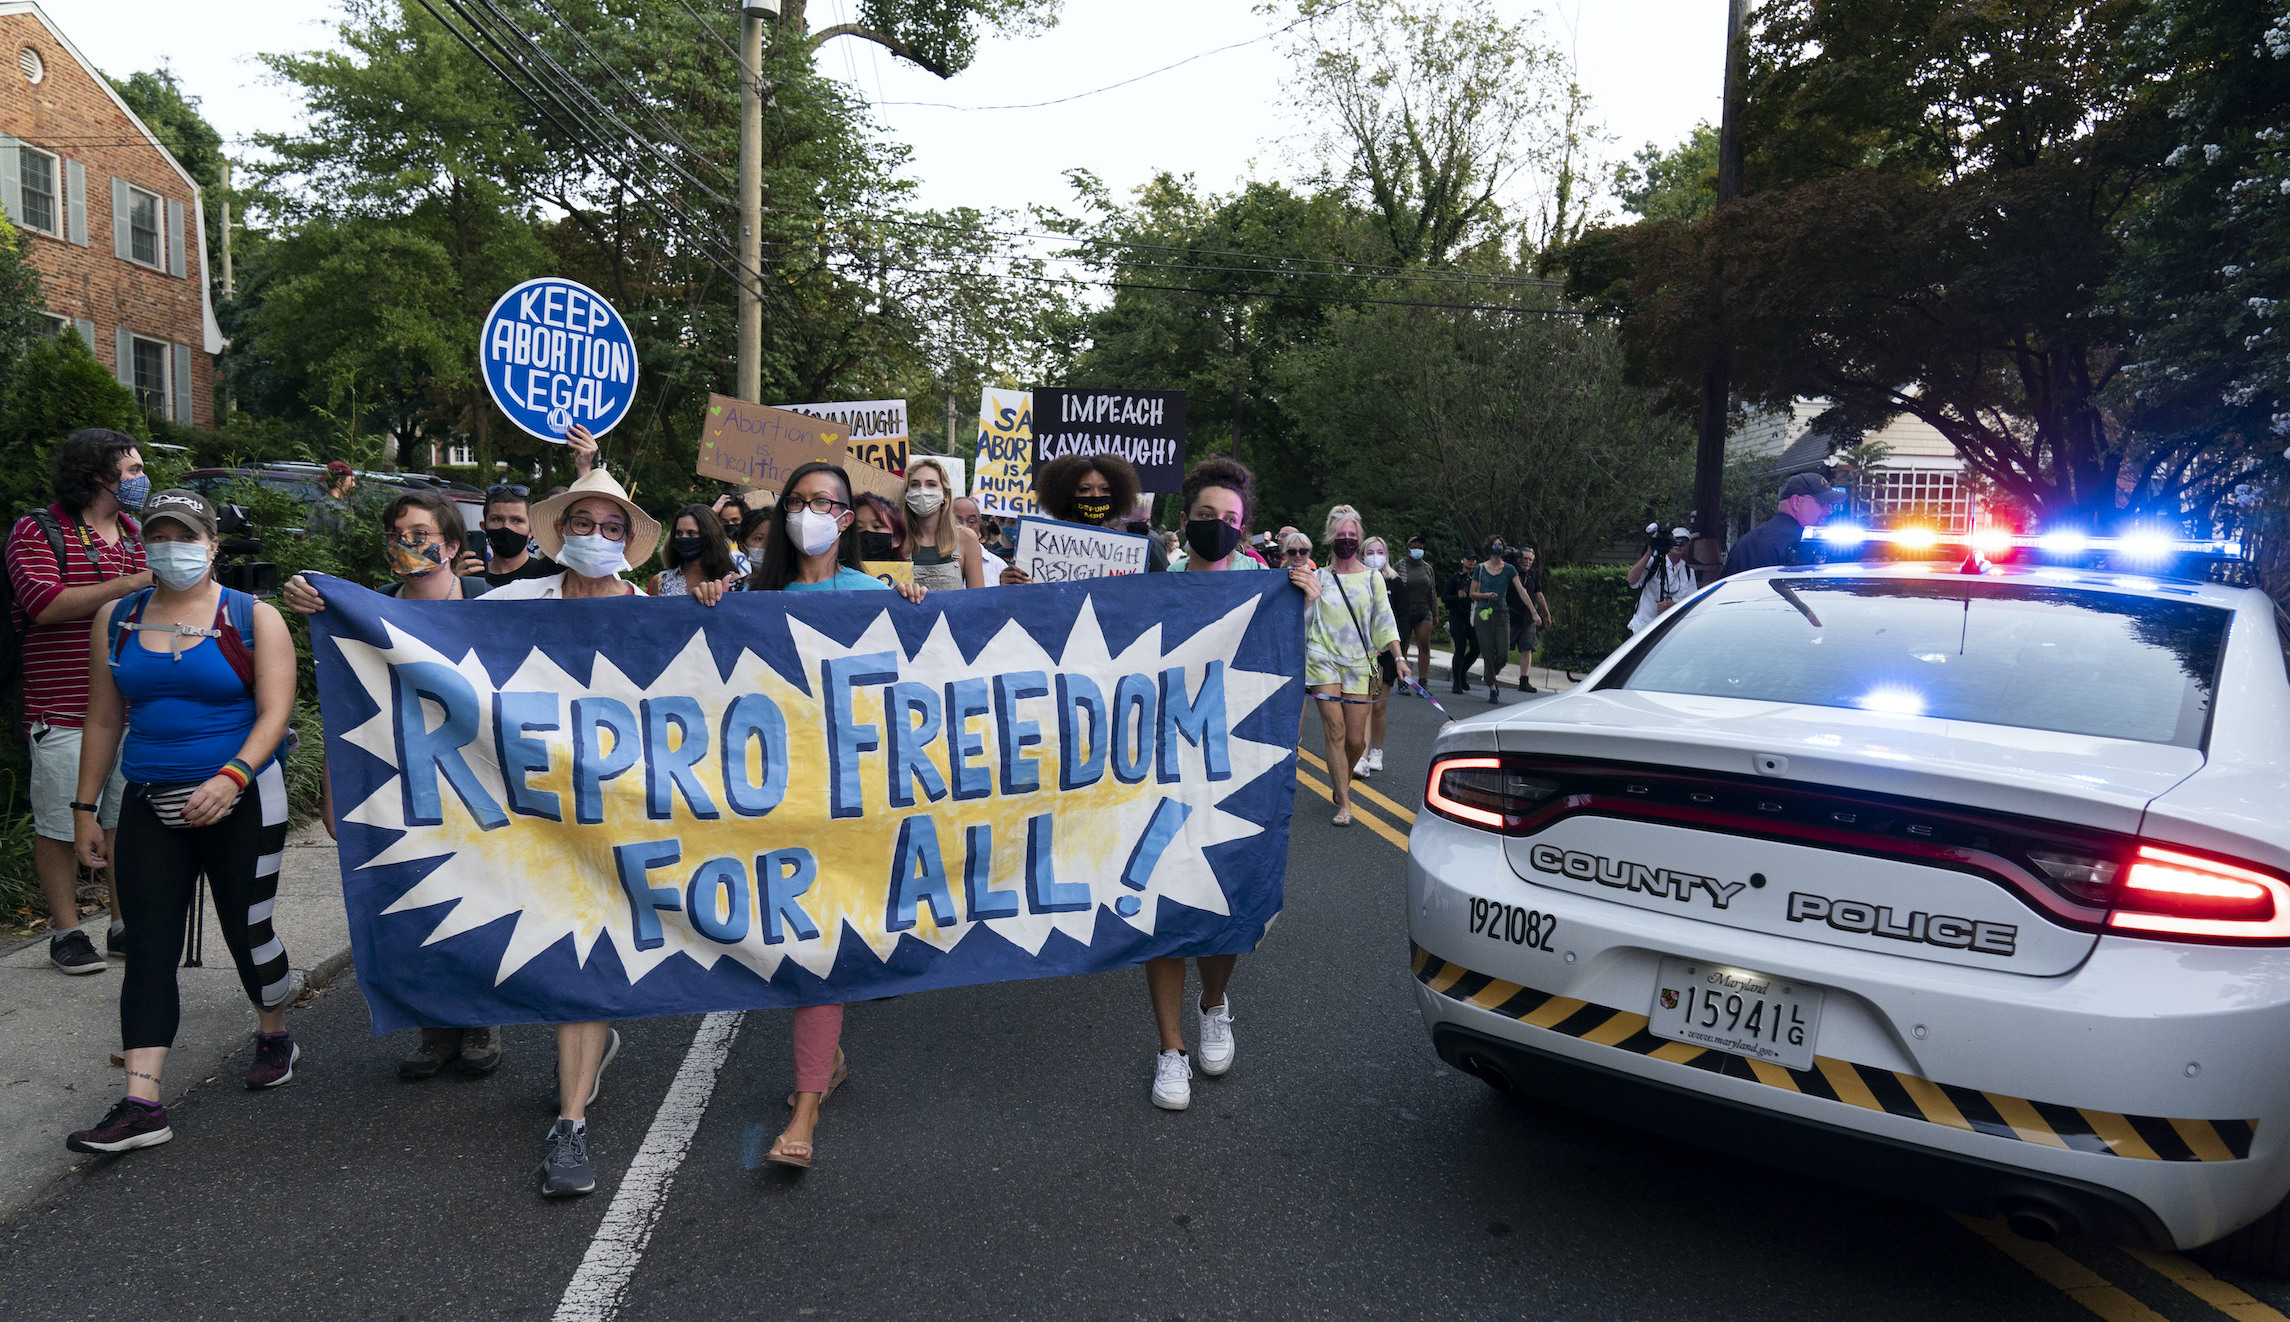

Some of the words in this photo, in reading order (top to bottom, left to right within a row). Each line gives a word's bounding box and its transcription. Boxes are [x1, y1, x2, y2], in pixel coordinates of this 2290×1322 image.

[520, 286, 610, 334] KEEP
[492, 318, 629, 384] ABORTION
[504, 364, 615, 420] LEGAL
[1061, 393, 1164, 426] IMPEACH
[723, 408, 813, 446] Abortion
[994, 408, 1033, 434] SA
[716, 446, 793, 483] healthc
[757, 444, 771, 457] is
[1039, 432, 1177, 466] KAVANAUGH!
[1003, 463, 1019, 477] IS
[984, 493, 1040, 515] RIGH
[1033, 528, 1145, 565] KAVANAUGH
[387, 660, 790, 832] REPRO
[821, 650, 1233, 820] FREEDOM
[613, 838, 820, 952] FOR
[1530, 843, 1746, 909] COUNTY
[1786, 891, 2018, 957] POLICE
[1468, 897, 1558, 954] 1921082
[1707, 971, 1771, 996] Maryland
[1685, 985, 1785, 1043] 15941
[1687, 1030, 1775, 1057] www.maryland.gov
